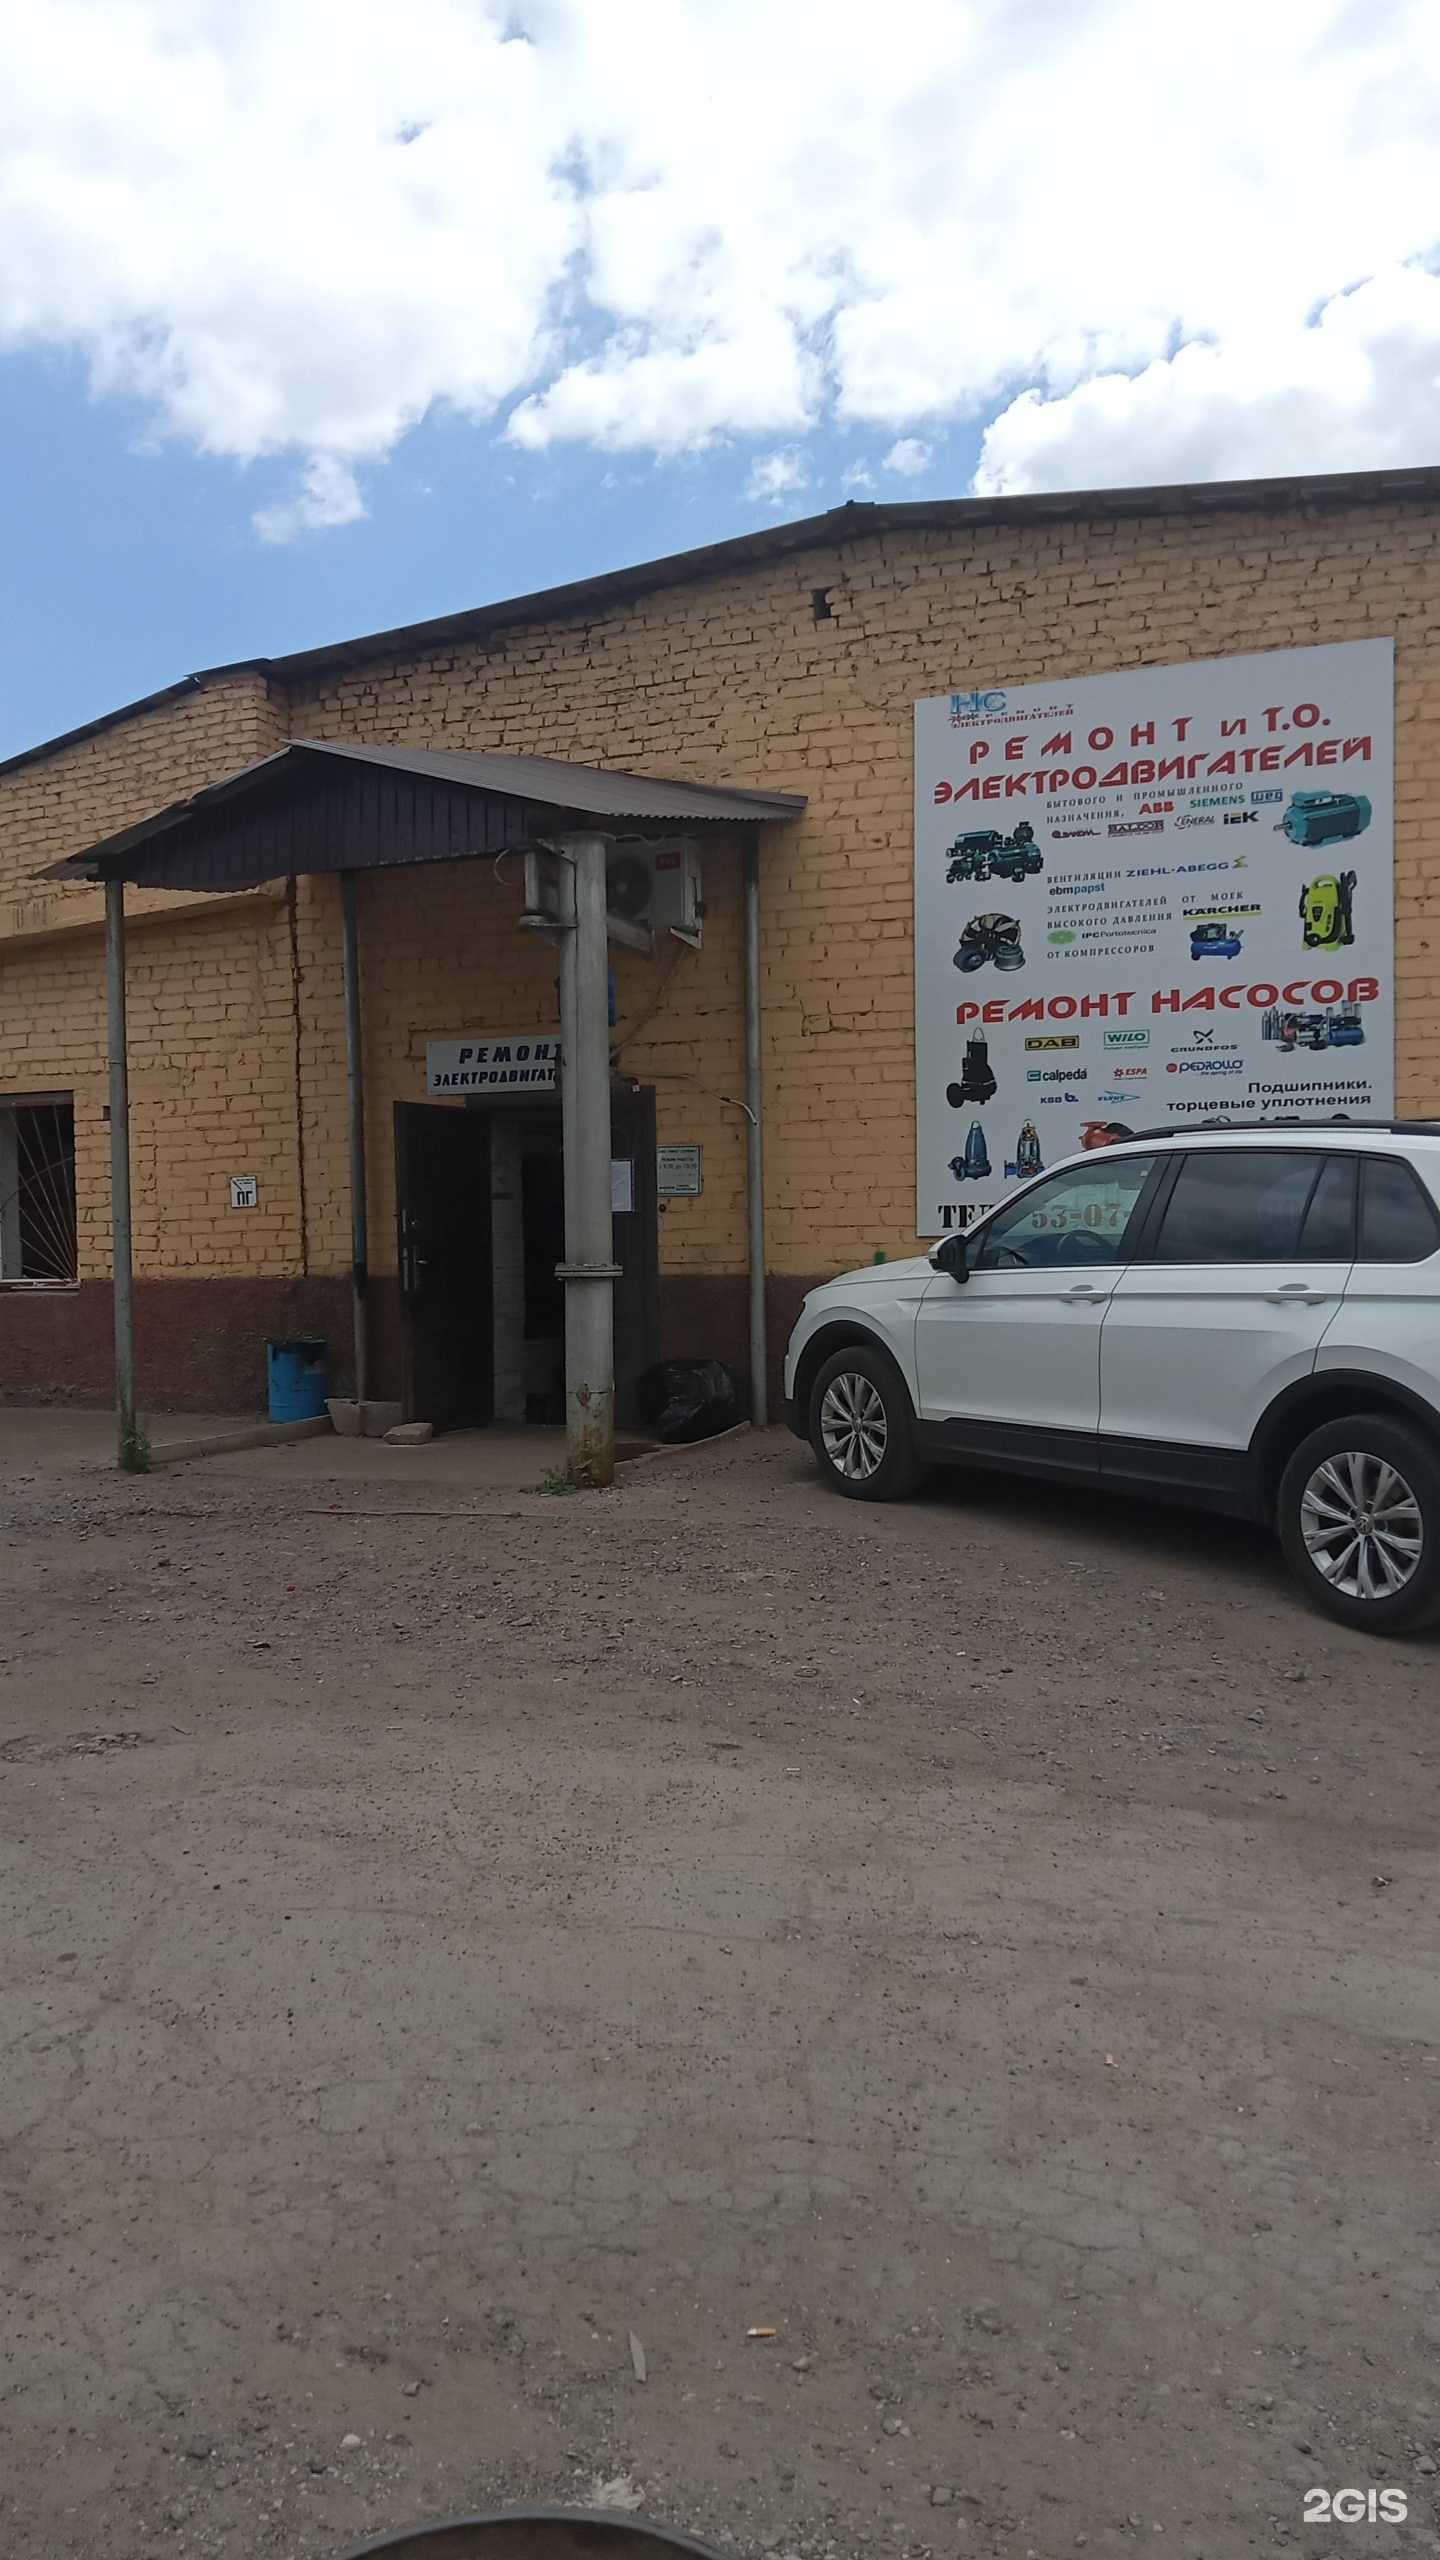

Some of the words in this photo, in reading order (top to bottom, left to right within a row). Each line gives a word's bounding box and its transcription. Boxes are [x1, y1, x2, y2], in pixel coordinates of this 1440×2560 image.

[969, 716, 1192, 765] РЕМОНТ
[1261, 703, 1331, 732] Т.О.
[934, 735, 1372, 804] ЭЛЕКТРОДВИГАТЕЛЕЙ
[1046, 795, 1106, 809] БЫТОВОГО
[1133, 782, 1244, 801] ПРОМЫШЛЕННОГО
[1190, 794, 1246, 809] SIEMENS
[1139, 801, 1174, 815] ABB
[1047, 871, 1121, 884] ВЕНТИЛЯЦИИ
[1126, 862, 1229, 878] ZIEHL-ABEGG
[1049, 883, 1105, 896] ebmpapst
[1047, 896, 1167, 914] ЭЛЕКТРОДВИГАТЕЛЕЙ
[1182, 895, 1196, 904] ОТ
[1211, 890, 1244, 901] МОЕК
[1047, 917, 1108, 929] ВЫСОКОГО
[1112, 912, 1172, 925] ДАВЛЕНИЯ
[1047, 951, 1060, 960] ОТ
[1064, 944, 1154, 958] КОМПРЕССОРОВ
[956, 991, 1136, 1025] РЕМОНТ
[1151, 977, 1379, 1014] НАСОСОВ
[1027, 1038, 1077, 1049] DAB
[1107, 1032, 1146, 1043] WILO
[1170, 1043, 1239, 1053] GRUNDFOS
[433, 1068, 556, 1087] ЭЛЕКТРОДВИГАТ
[1042, 1068, 1087, 1083] calpeda
[1167, 1099, 1256, 1112] торцевые
[1261, 1095, 1372, 1111] уплотнения
[236, 1190, 253, 1206] ПГ
